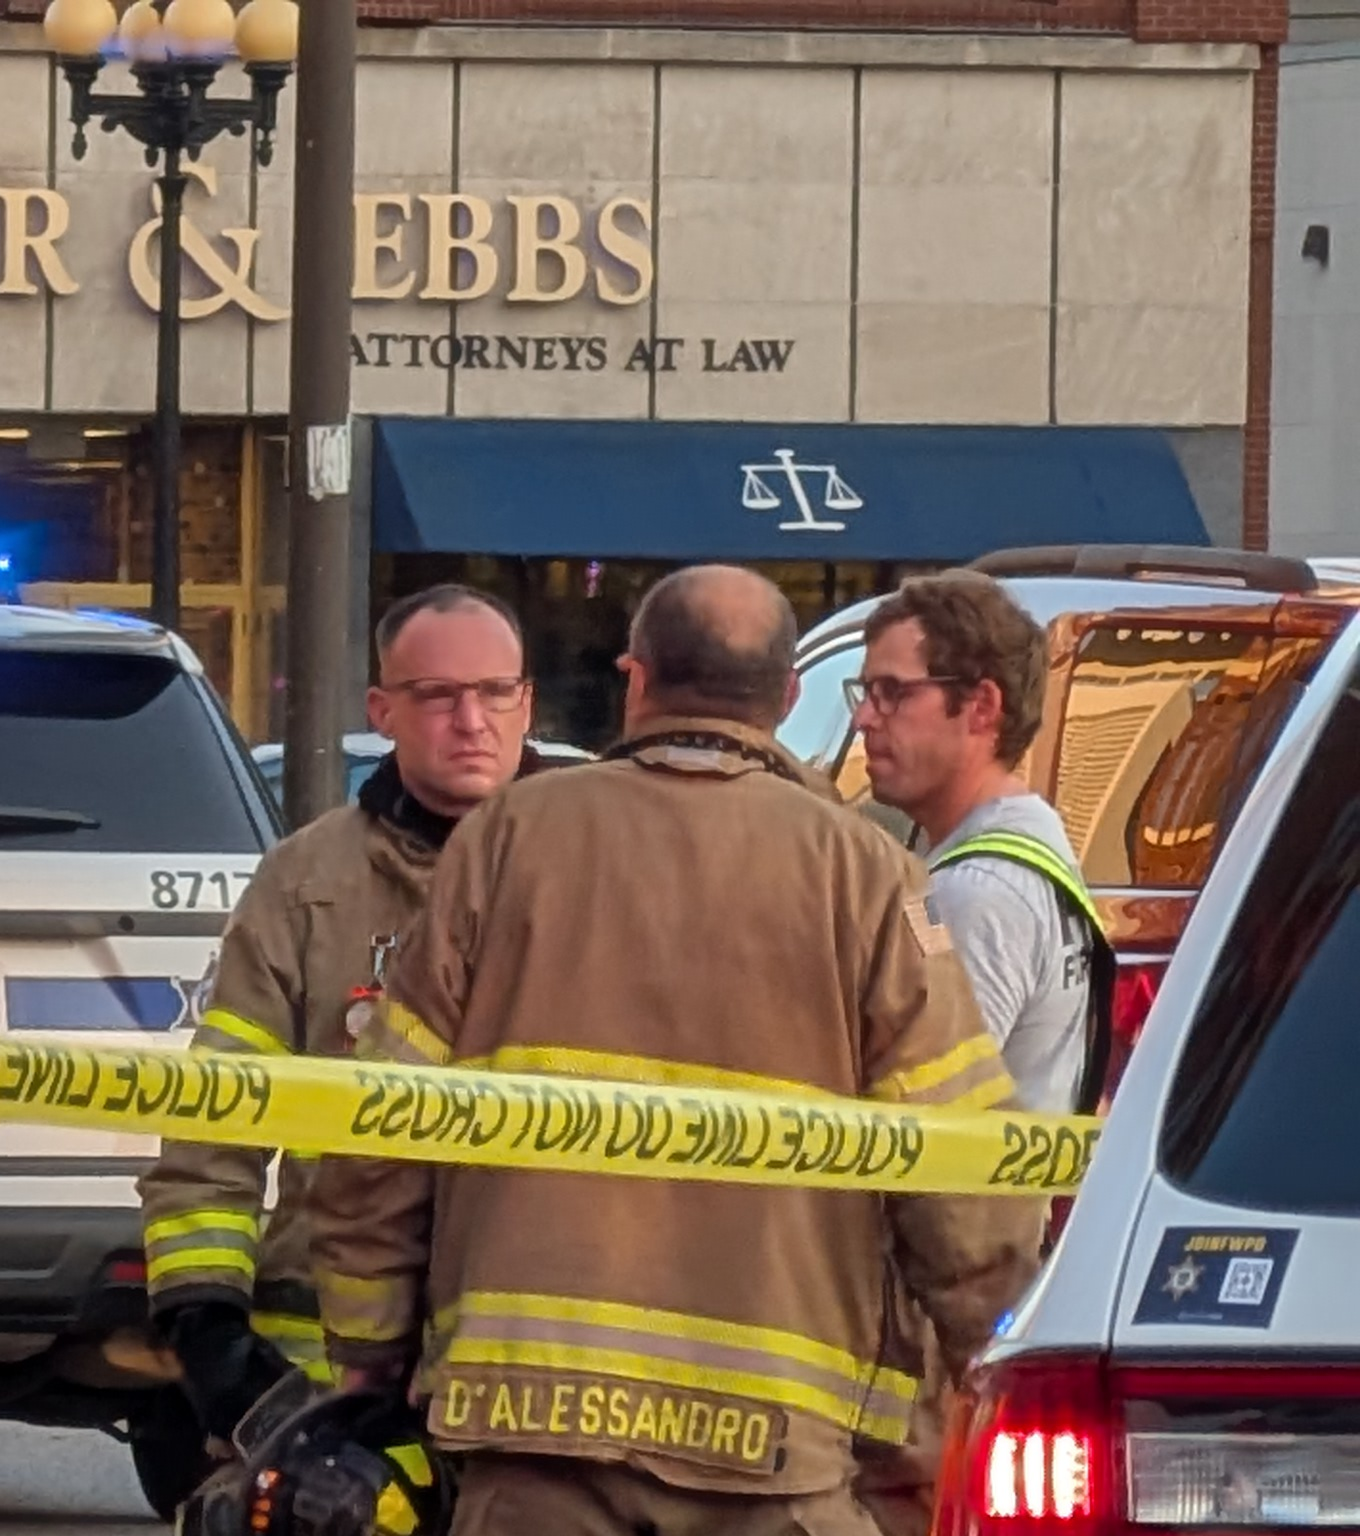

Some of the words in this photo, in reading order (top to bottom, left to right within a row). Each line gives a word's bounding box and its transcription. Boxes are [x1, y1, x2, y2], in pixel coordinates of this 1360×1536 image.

[128, 163, 292, 323] &
[350, 332, 607, 372] ATTORNEYS
[625, 336, 684, 373] AT
[705, 339, 794, 373] LAW
[443, 1379, 769, 1463] D'ALESSANDRO
